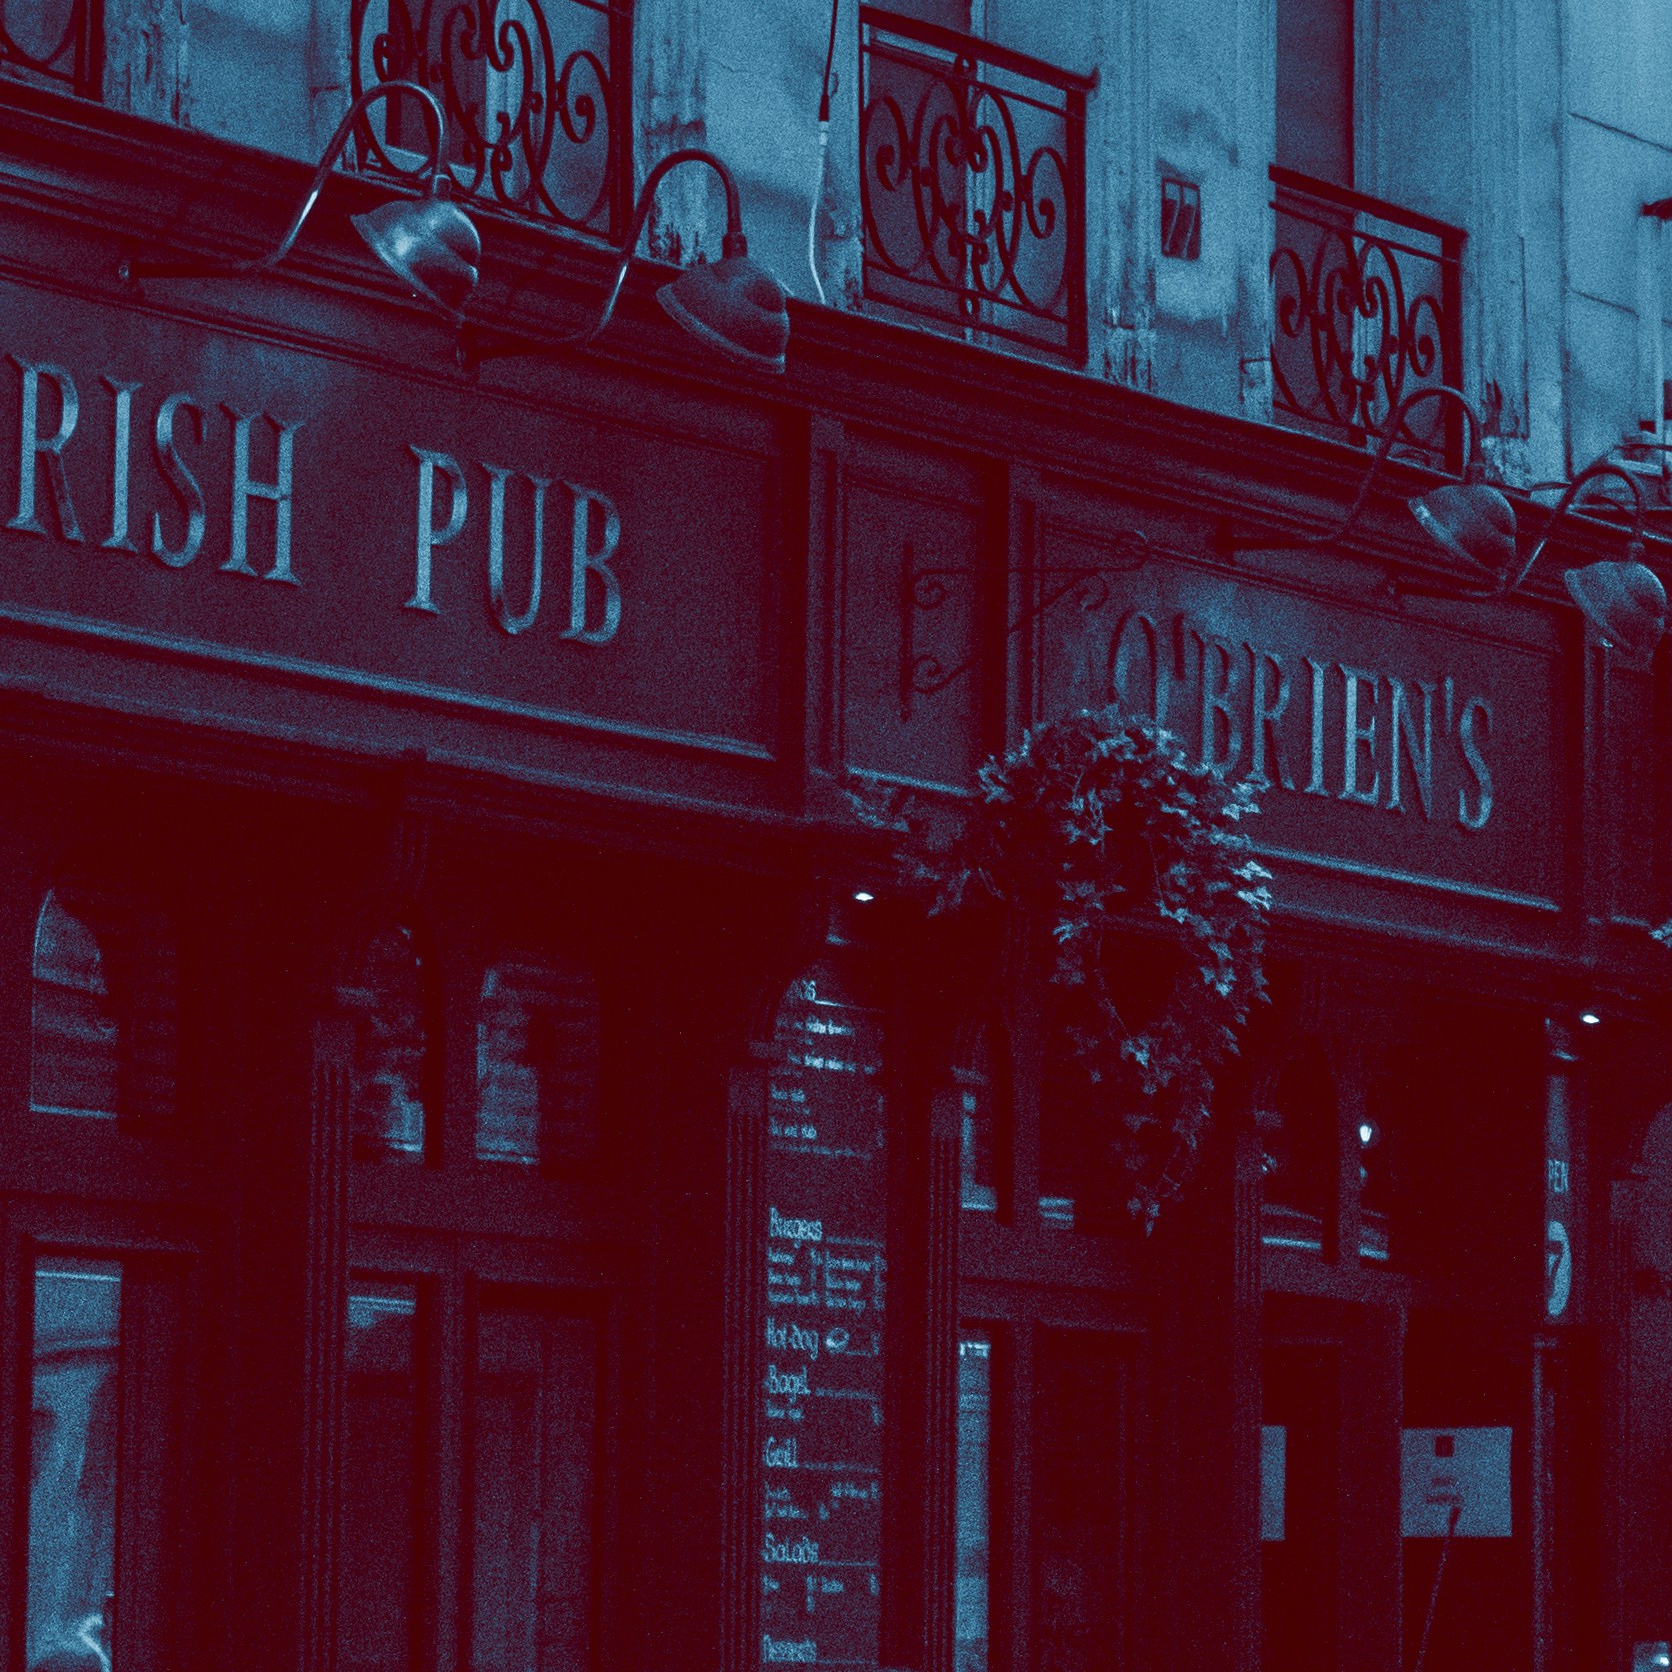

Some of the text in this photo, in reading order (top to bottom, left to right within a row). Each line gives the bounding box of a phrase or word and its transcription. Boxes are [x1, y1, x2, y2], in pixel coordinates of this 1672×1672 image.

[4, 353, 623, 644] RISH PUB
[1109, 610, 1496, 832] O'BRIEN'S
